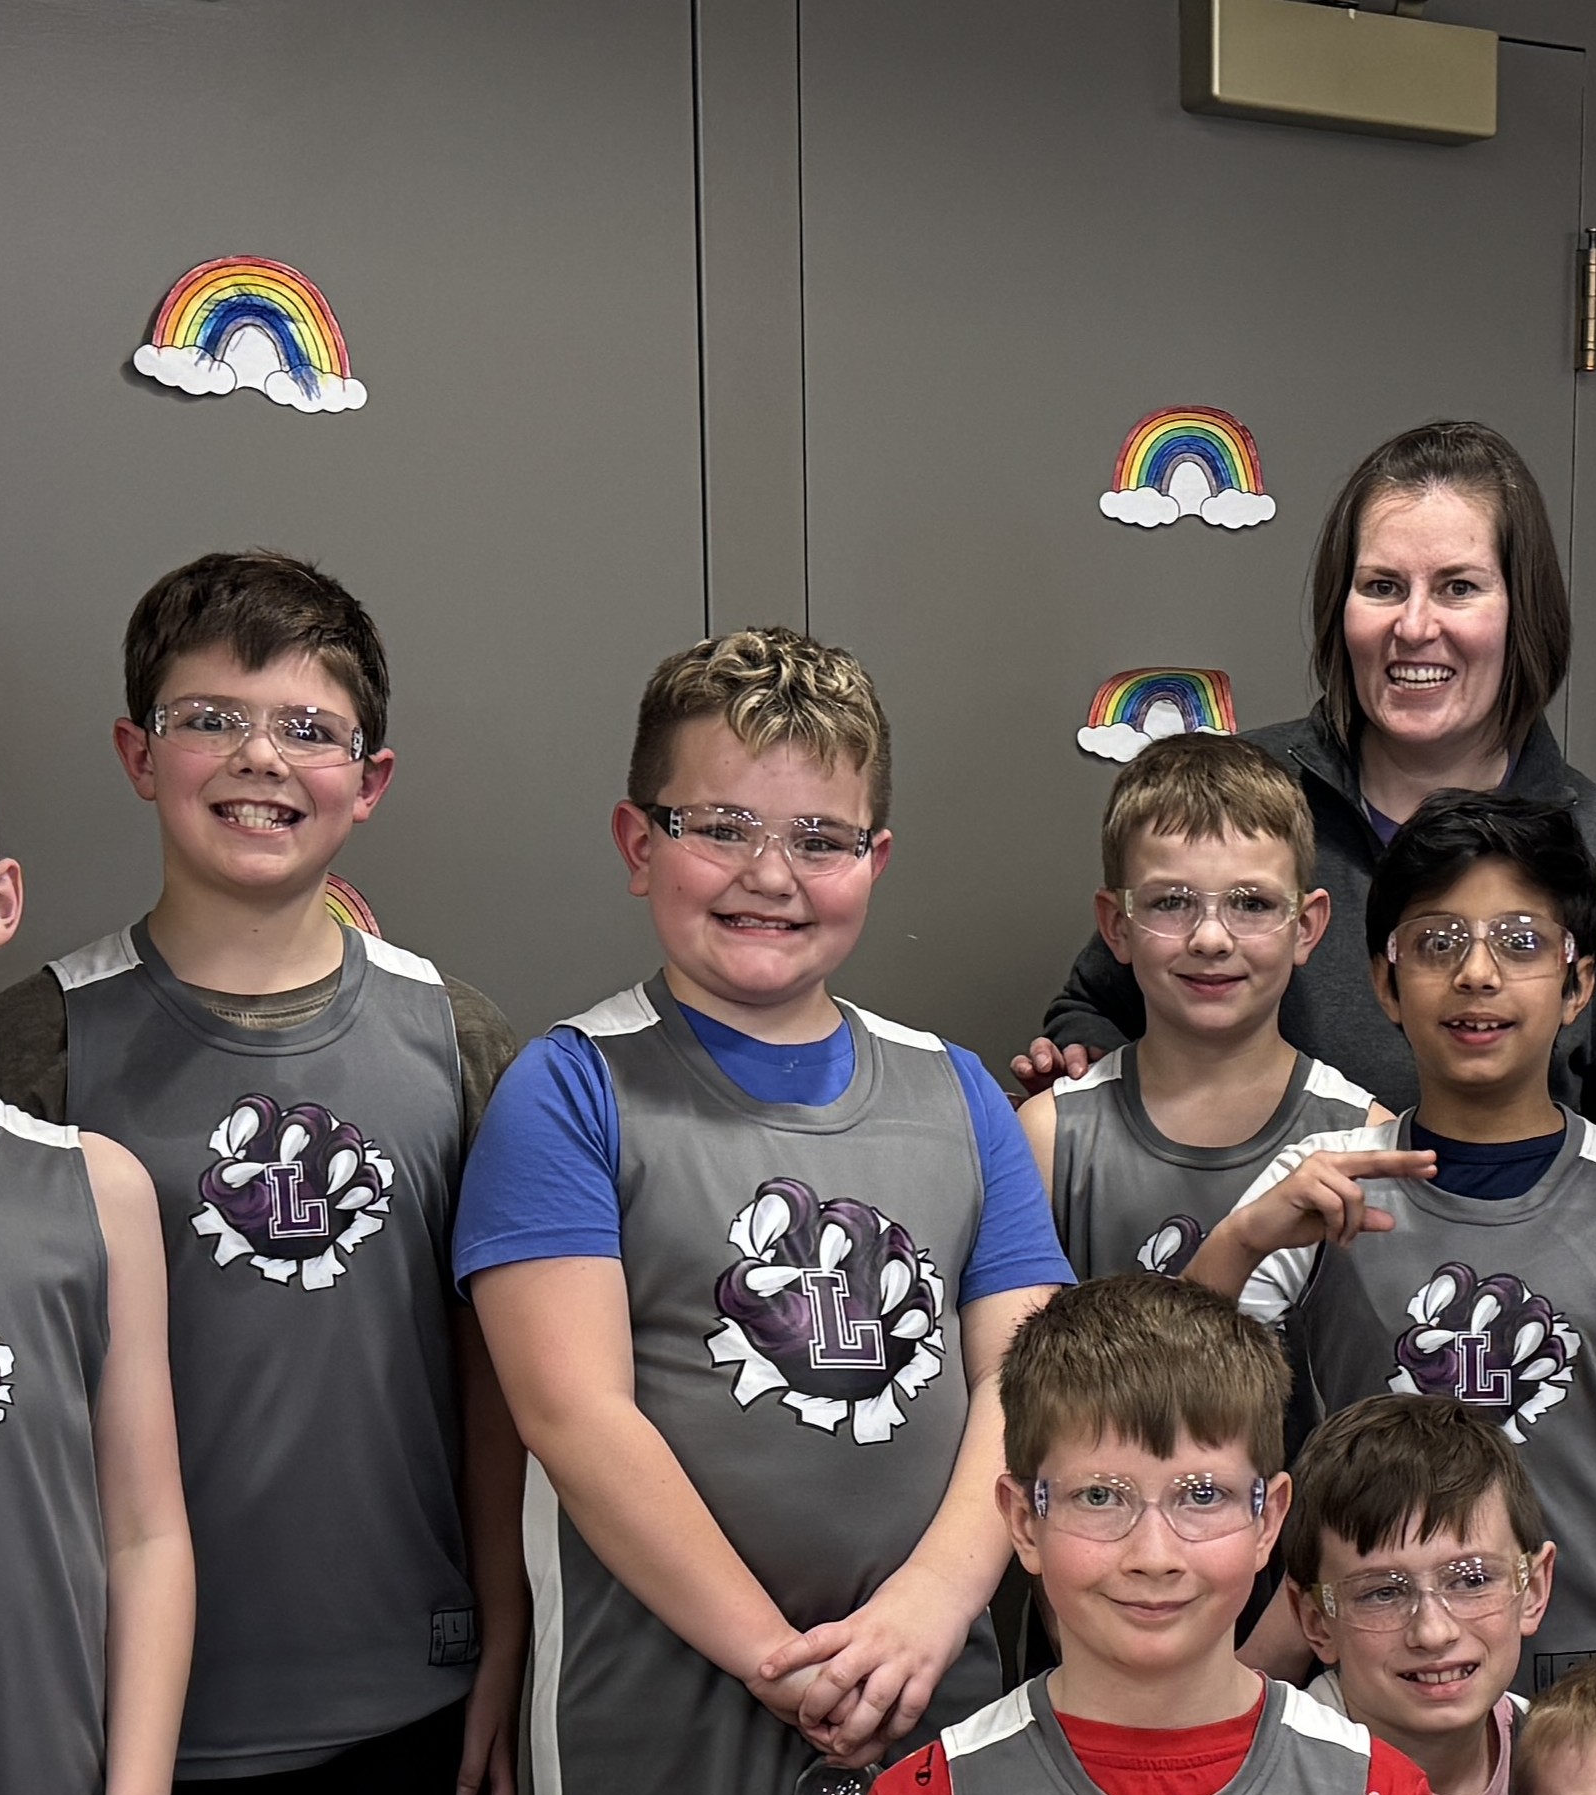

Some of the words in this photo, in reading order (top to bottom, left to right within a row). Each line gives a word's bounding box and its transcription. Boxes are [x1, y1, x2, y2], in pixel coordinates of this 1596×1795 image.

[265, 1160, 330, 1239] L
[801, 1268, 887, 1371] L
[1454, 1330, 1512, 1407] L
